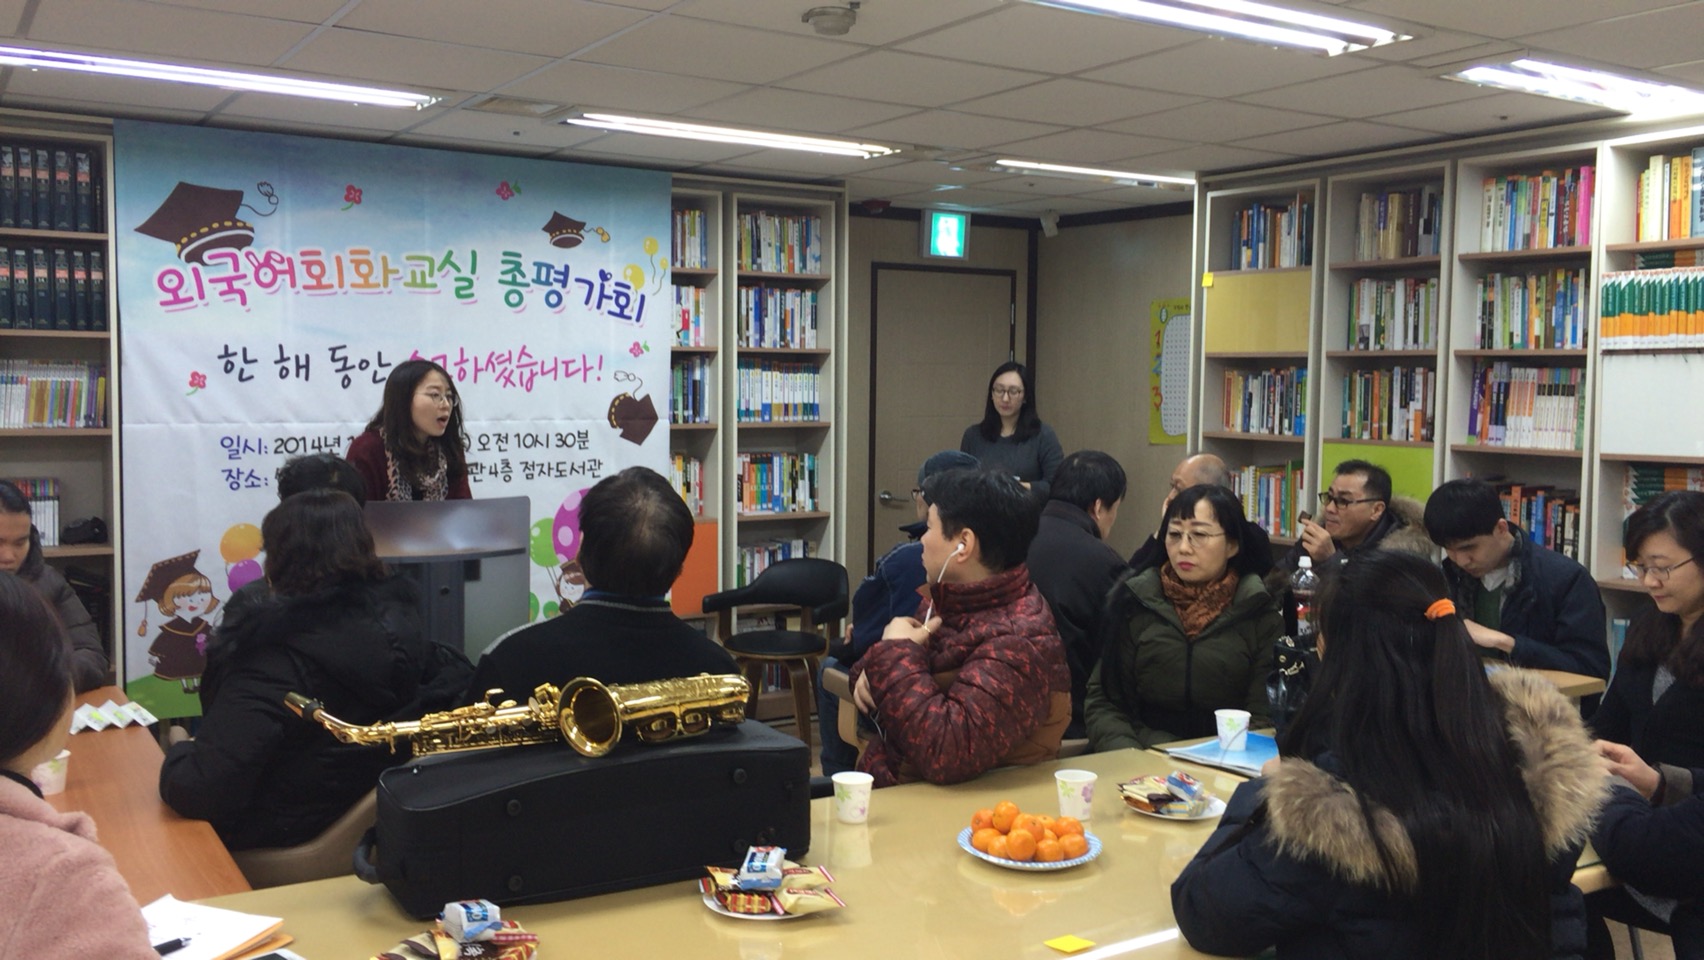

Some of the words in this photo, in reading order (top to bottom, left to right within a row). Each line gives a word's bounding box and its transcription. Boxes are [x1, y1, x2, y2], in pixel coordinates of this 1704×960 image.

[156, 248, 477, 308] 외국어회화교실
[497, 250, 646, 323] 총평가회
[217, 344, 259, 383] 한
[273, 343, 311, 381] 해
[328, 344, 393, 390] 동안
[409, 344, 603, 393] 하셨습니다!
[220, 435, 268, 460] 일시:
[273, 436, 341, 457] 2014년
[477, 432, 509, 452] 오전
[513, 433, 549, 449] 10시
[555, 430, 590, 450] 30분
[221, 468, 268, 491] 장소:
[520, 459, 604, 479] 점자도서관
